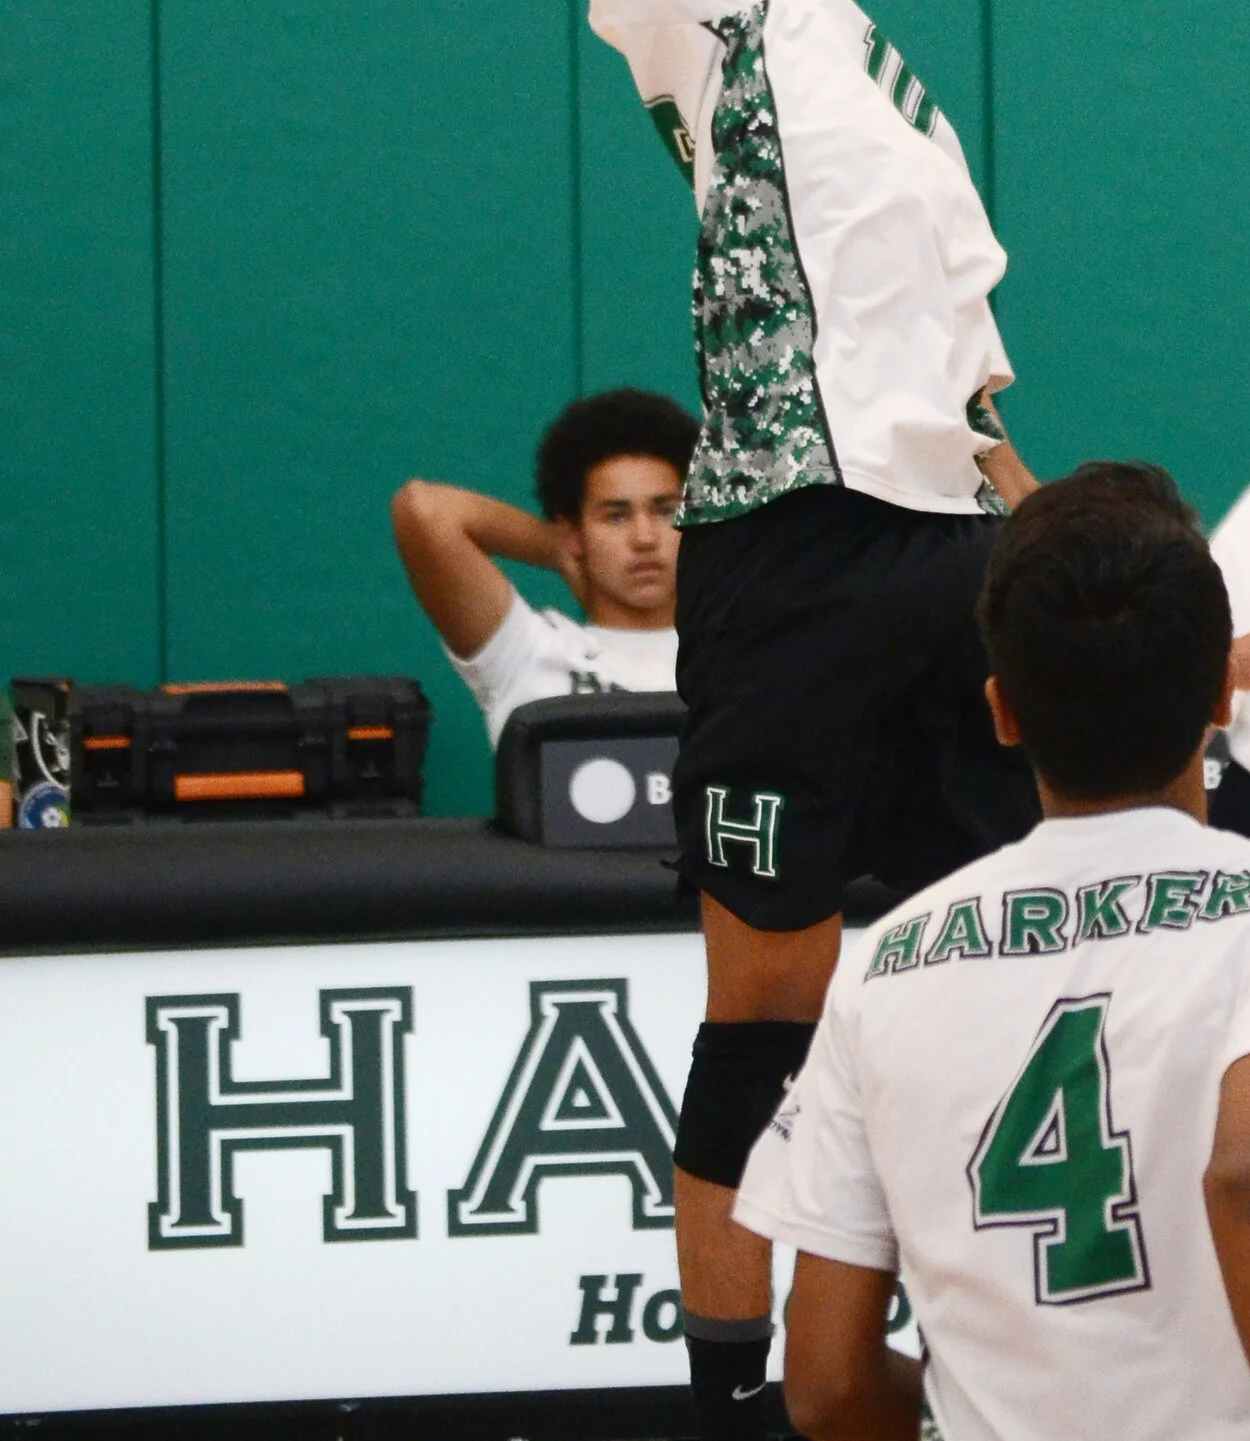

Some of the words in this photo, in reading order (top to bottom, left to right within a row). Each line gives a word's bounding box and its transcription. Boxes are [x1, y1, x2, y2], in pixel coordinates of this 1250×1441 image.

[707, 787, 781, 877] H
[966, 991, 1152, 1306] 4
[569, 1273, 685, 1345] Ho
